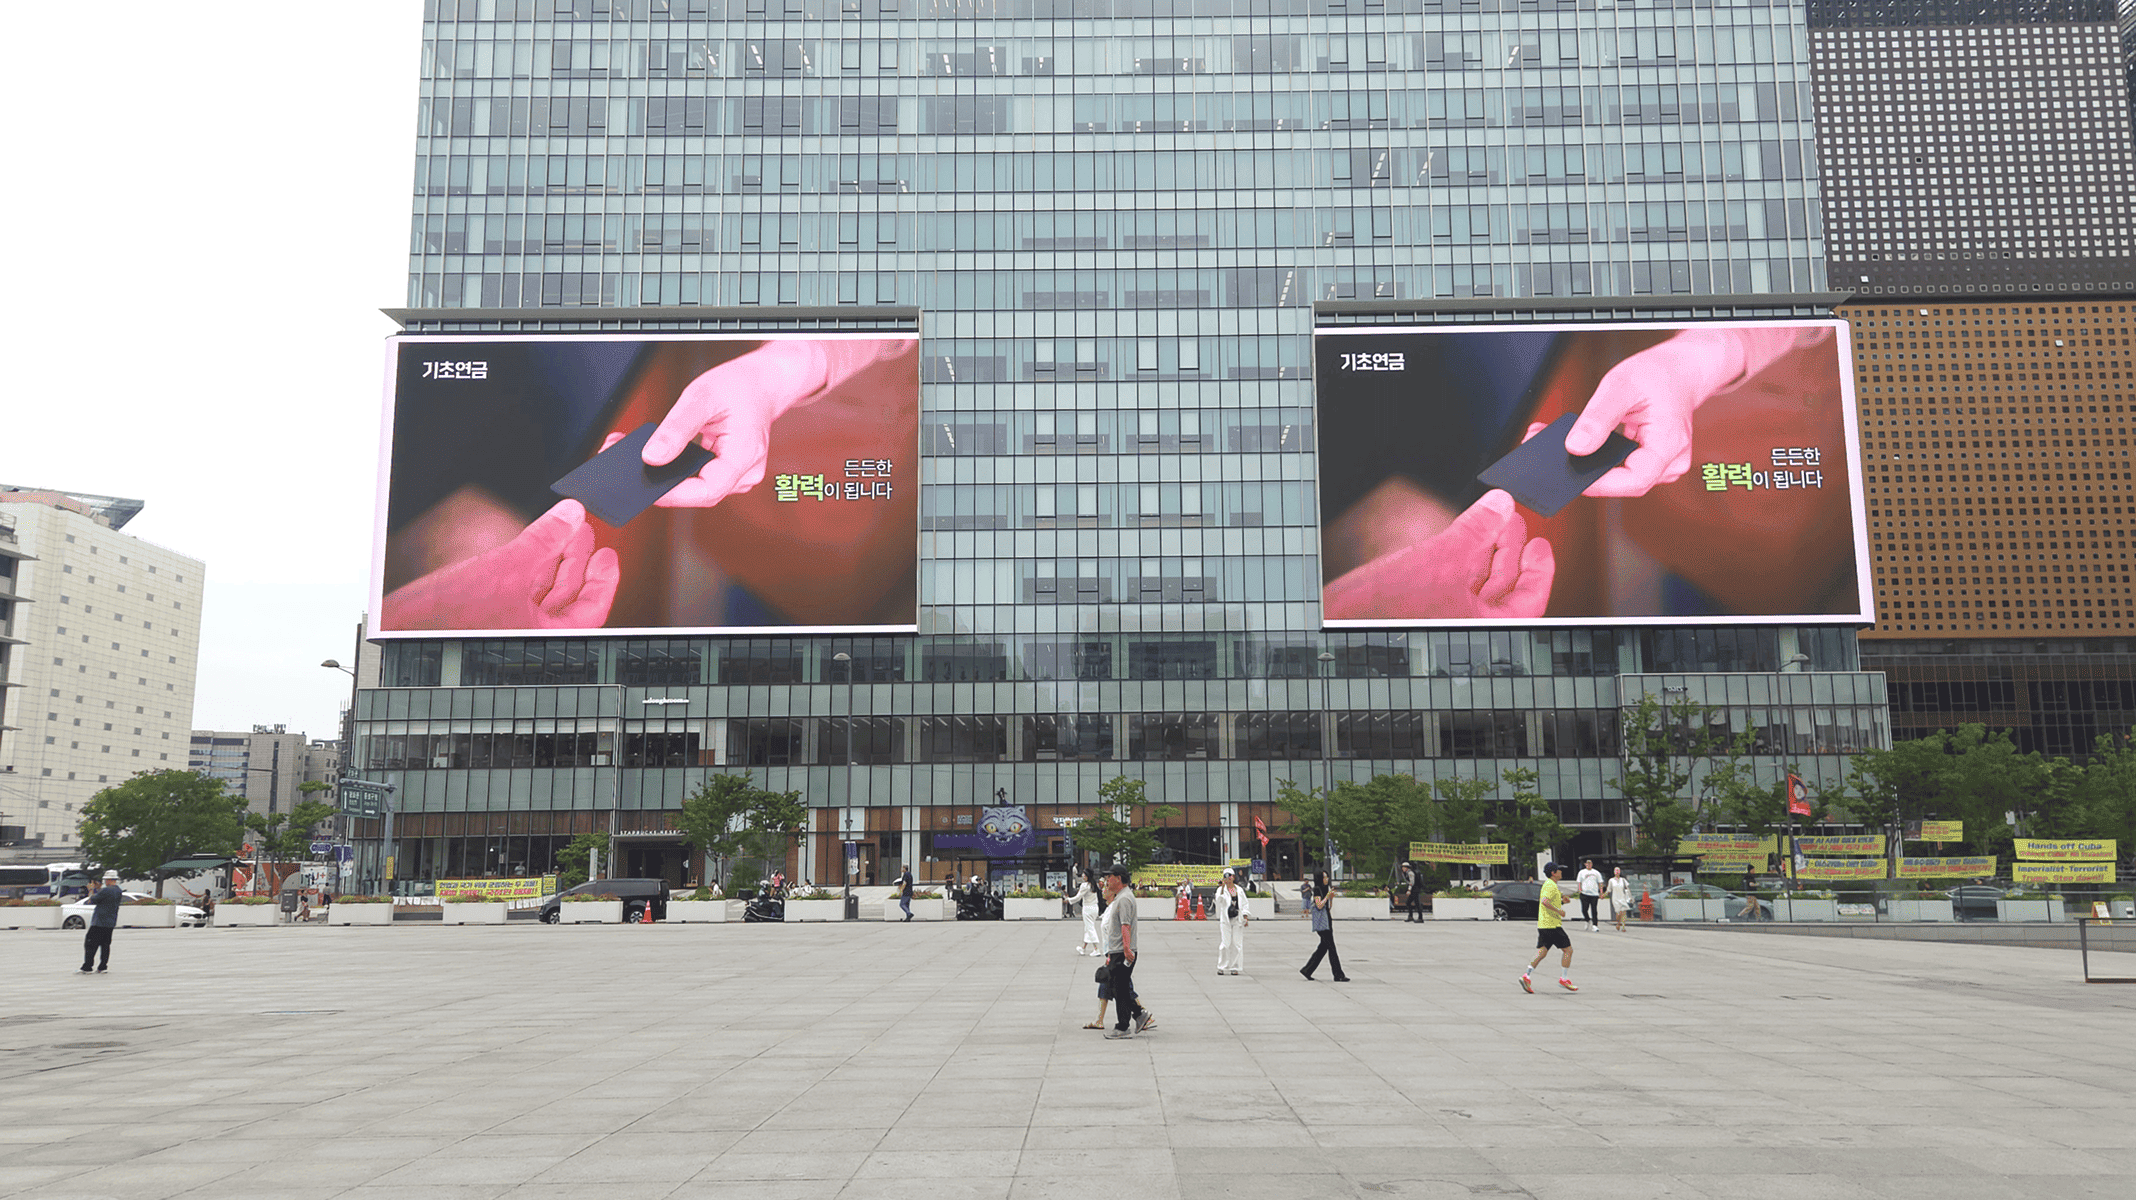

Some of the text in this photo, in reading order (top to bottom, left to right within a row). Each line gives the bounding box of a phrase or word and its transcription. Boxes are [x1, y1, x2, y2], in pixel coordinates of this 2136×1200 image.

[422, 360, 488, 380] 기초연금
[1340, 352, 1405, 371] 기초연금
[1771, 447, 1821, 466] 든든한
[844, 459, 893, 478] 든든한
[1702, 462, 1823, 491] 활력이 됩니다
[775, 474, 893, 501] 활력이 됩니다
[2028, 842, 2058, 850] Hands
[2061, 842, 2075, 850] off
